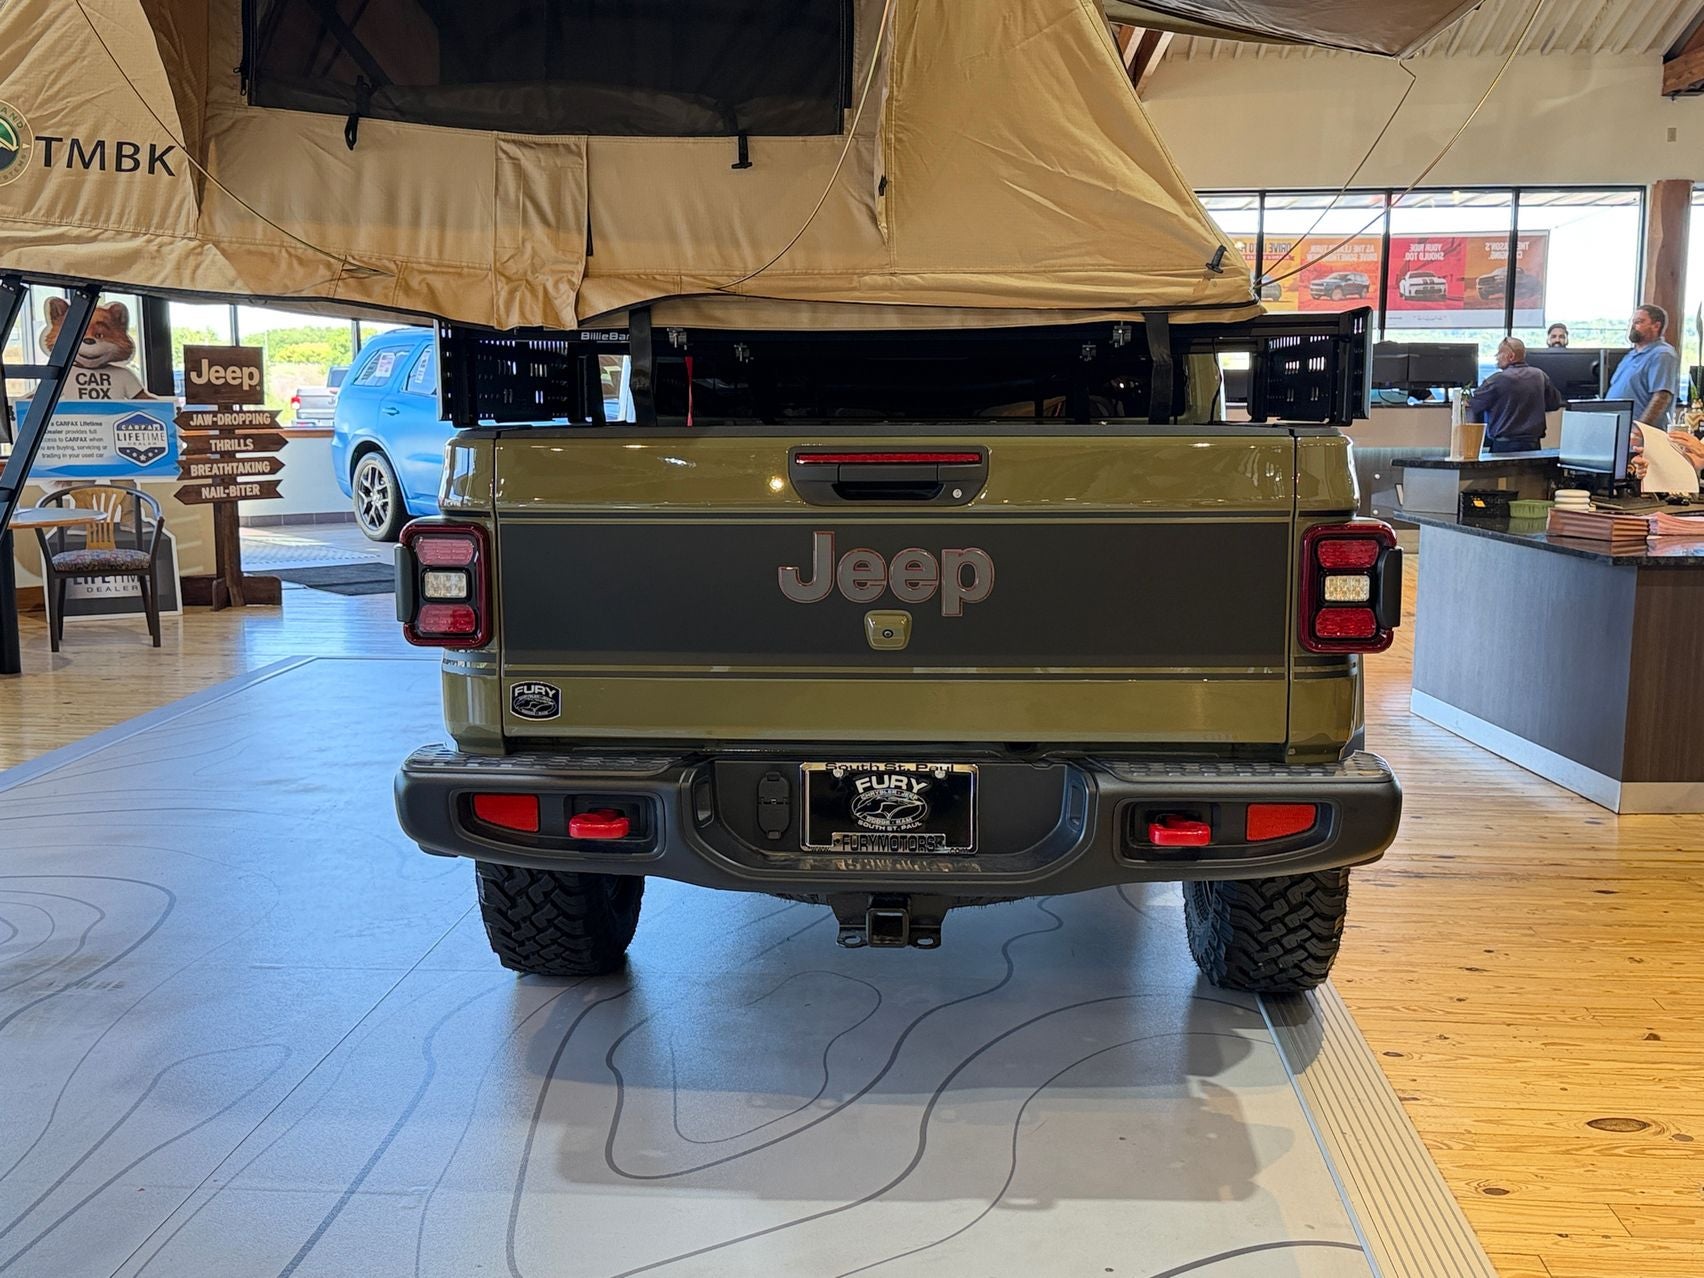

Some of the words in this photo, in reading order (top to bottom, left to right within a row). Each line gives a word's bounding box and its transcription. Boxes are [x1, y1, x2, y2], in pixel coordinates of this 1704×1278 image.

[35, 136, 176, 177] TMBK
[75, 372, 112, 386] CAR
[190, 358, 260, 391] Jeep
[78, 387, 112, 400] FOX
[189, 411, 271, 427] JAW-DROPPING
[116, 432, 165, 442] LIFETIME
[209, 438, 254, 451] THRILLS
[189, 461, 271, 477] BREATHTAKING
[201, 484, 261, 499] NAIL-BITER
[778, 531, 995, 617] Jeep
[86, 585, 139, 593] DEALER
[514, 684, 557, 698] FURY
[825, 763, 880, 773] South
[855, 774, 928, 794] FURY
[857, 820, 885, 832] SOUTH
[900, 820, 923, 832] PAUL
[841, 834, 937, 852] FURYMOTORS
